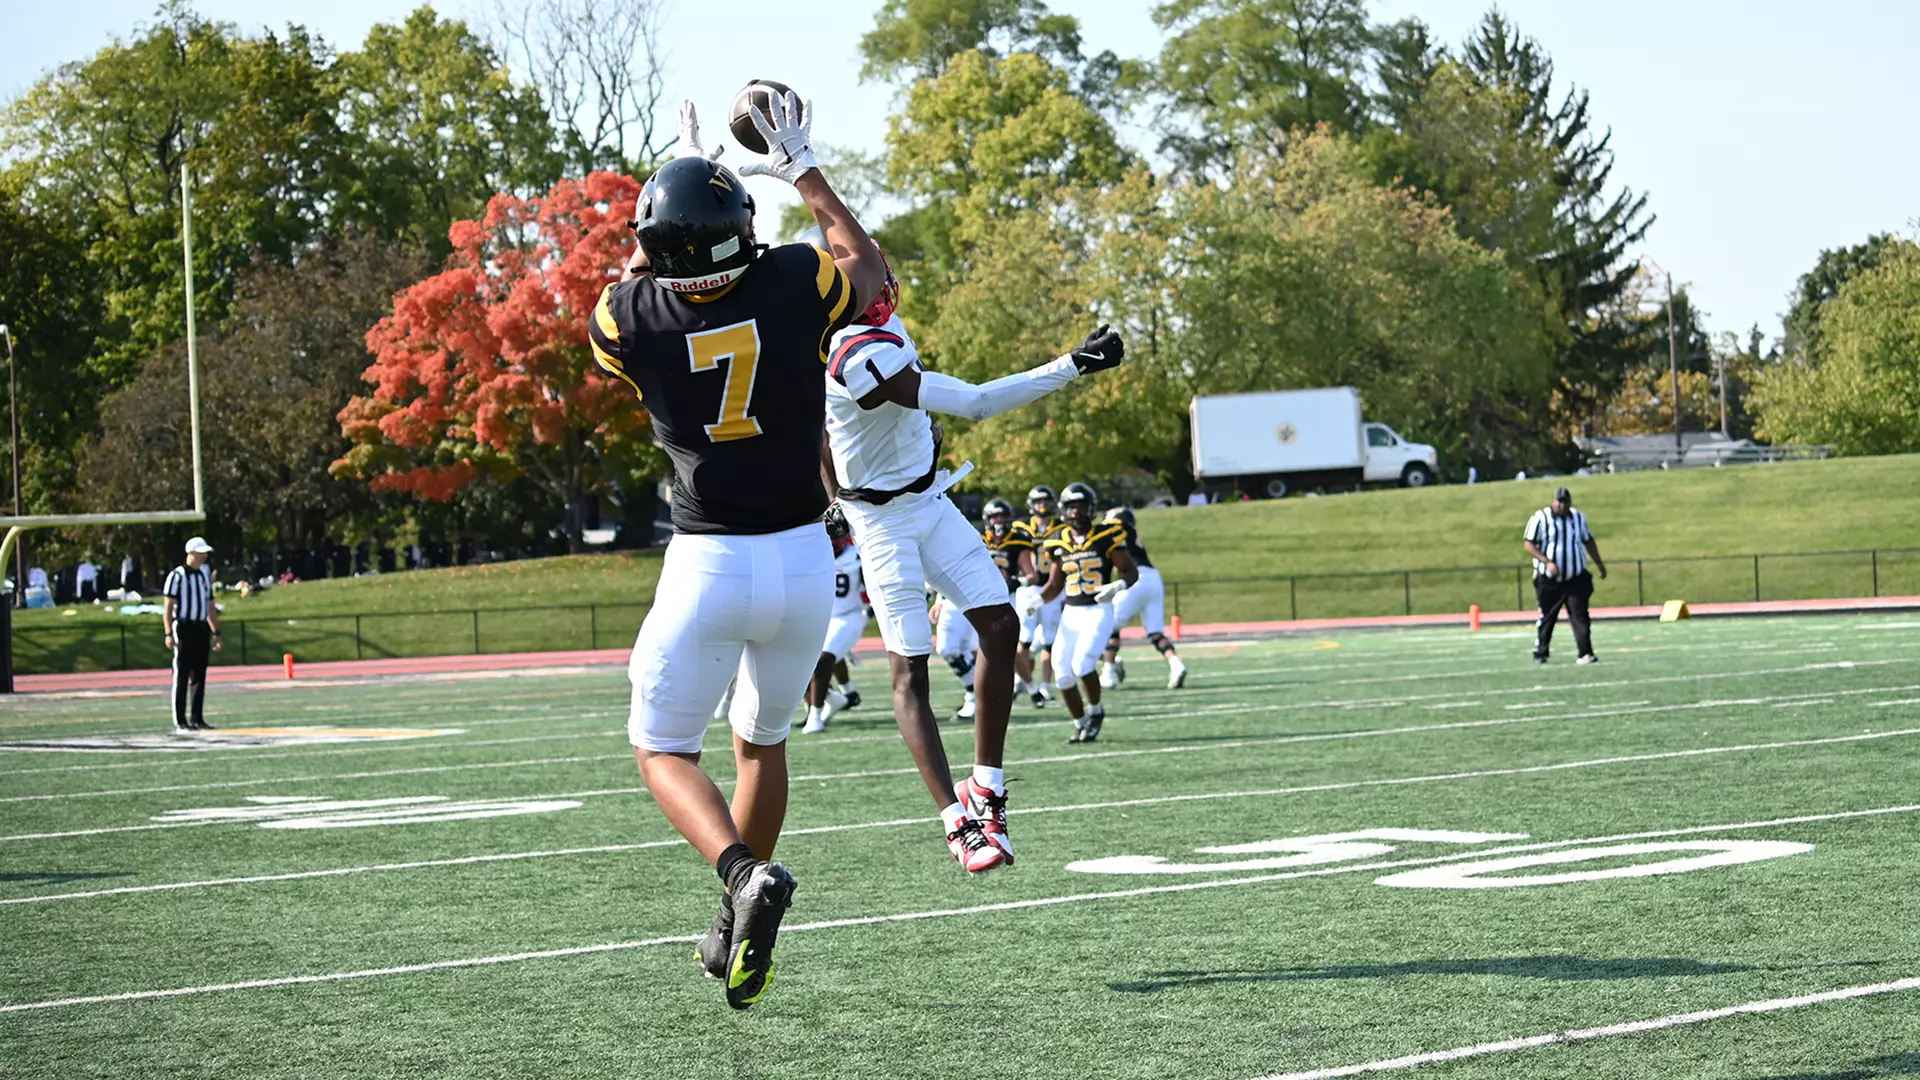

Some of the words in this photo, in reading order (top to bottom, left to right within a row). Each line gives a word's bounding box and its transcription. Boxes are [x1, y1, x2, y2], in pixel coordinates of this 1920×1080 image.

[670, 273, 731, 292] Riddell
[685, 317, 764, 443] 7
[864, 358, 886, 385] 1
[835, 573, 850, 598] 9
[1062, 557, 1103, 597] 25
[1065, 828, 1816, 889] 50
